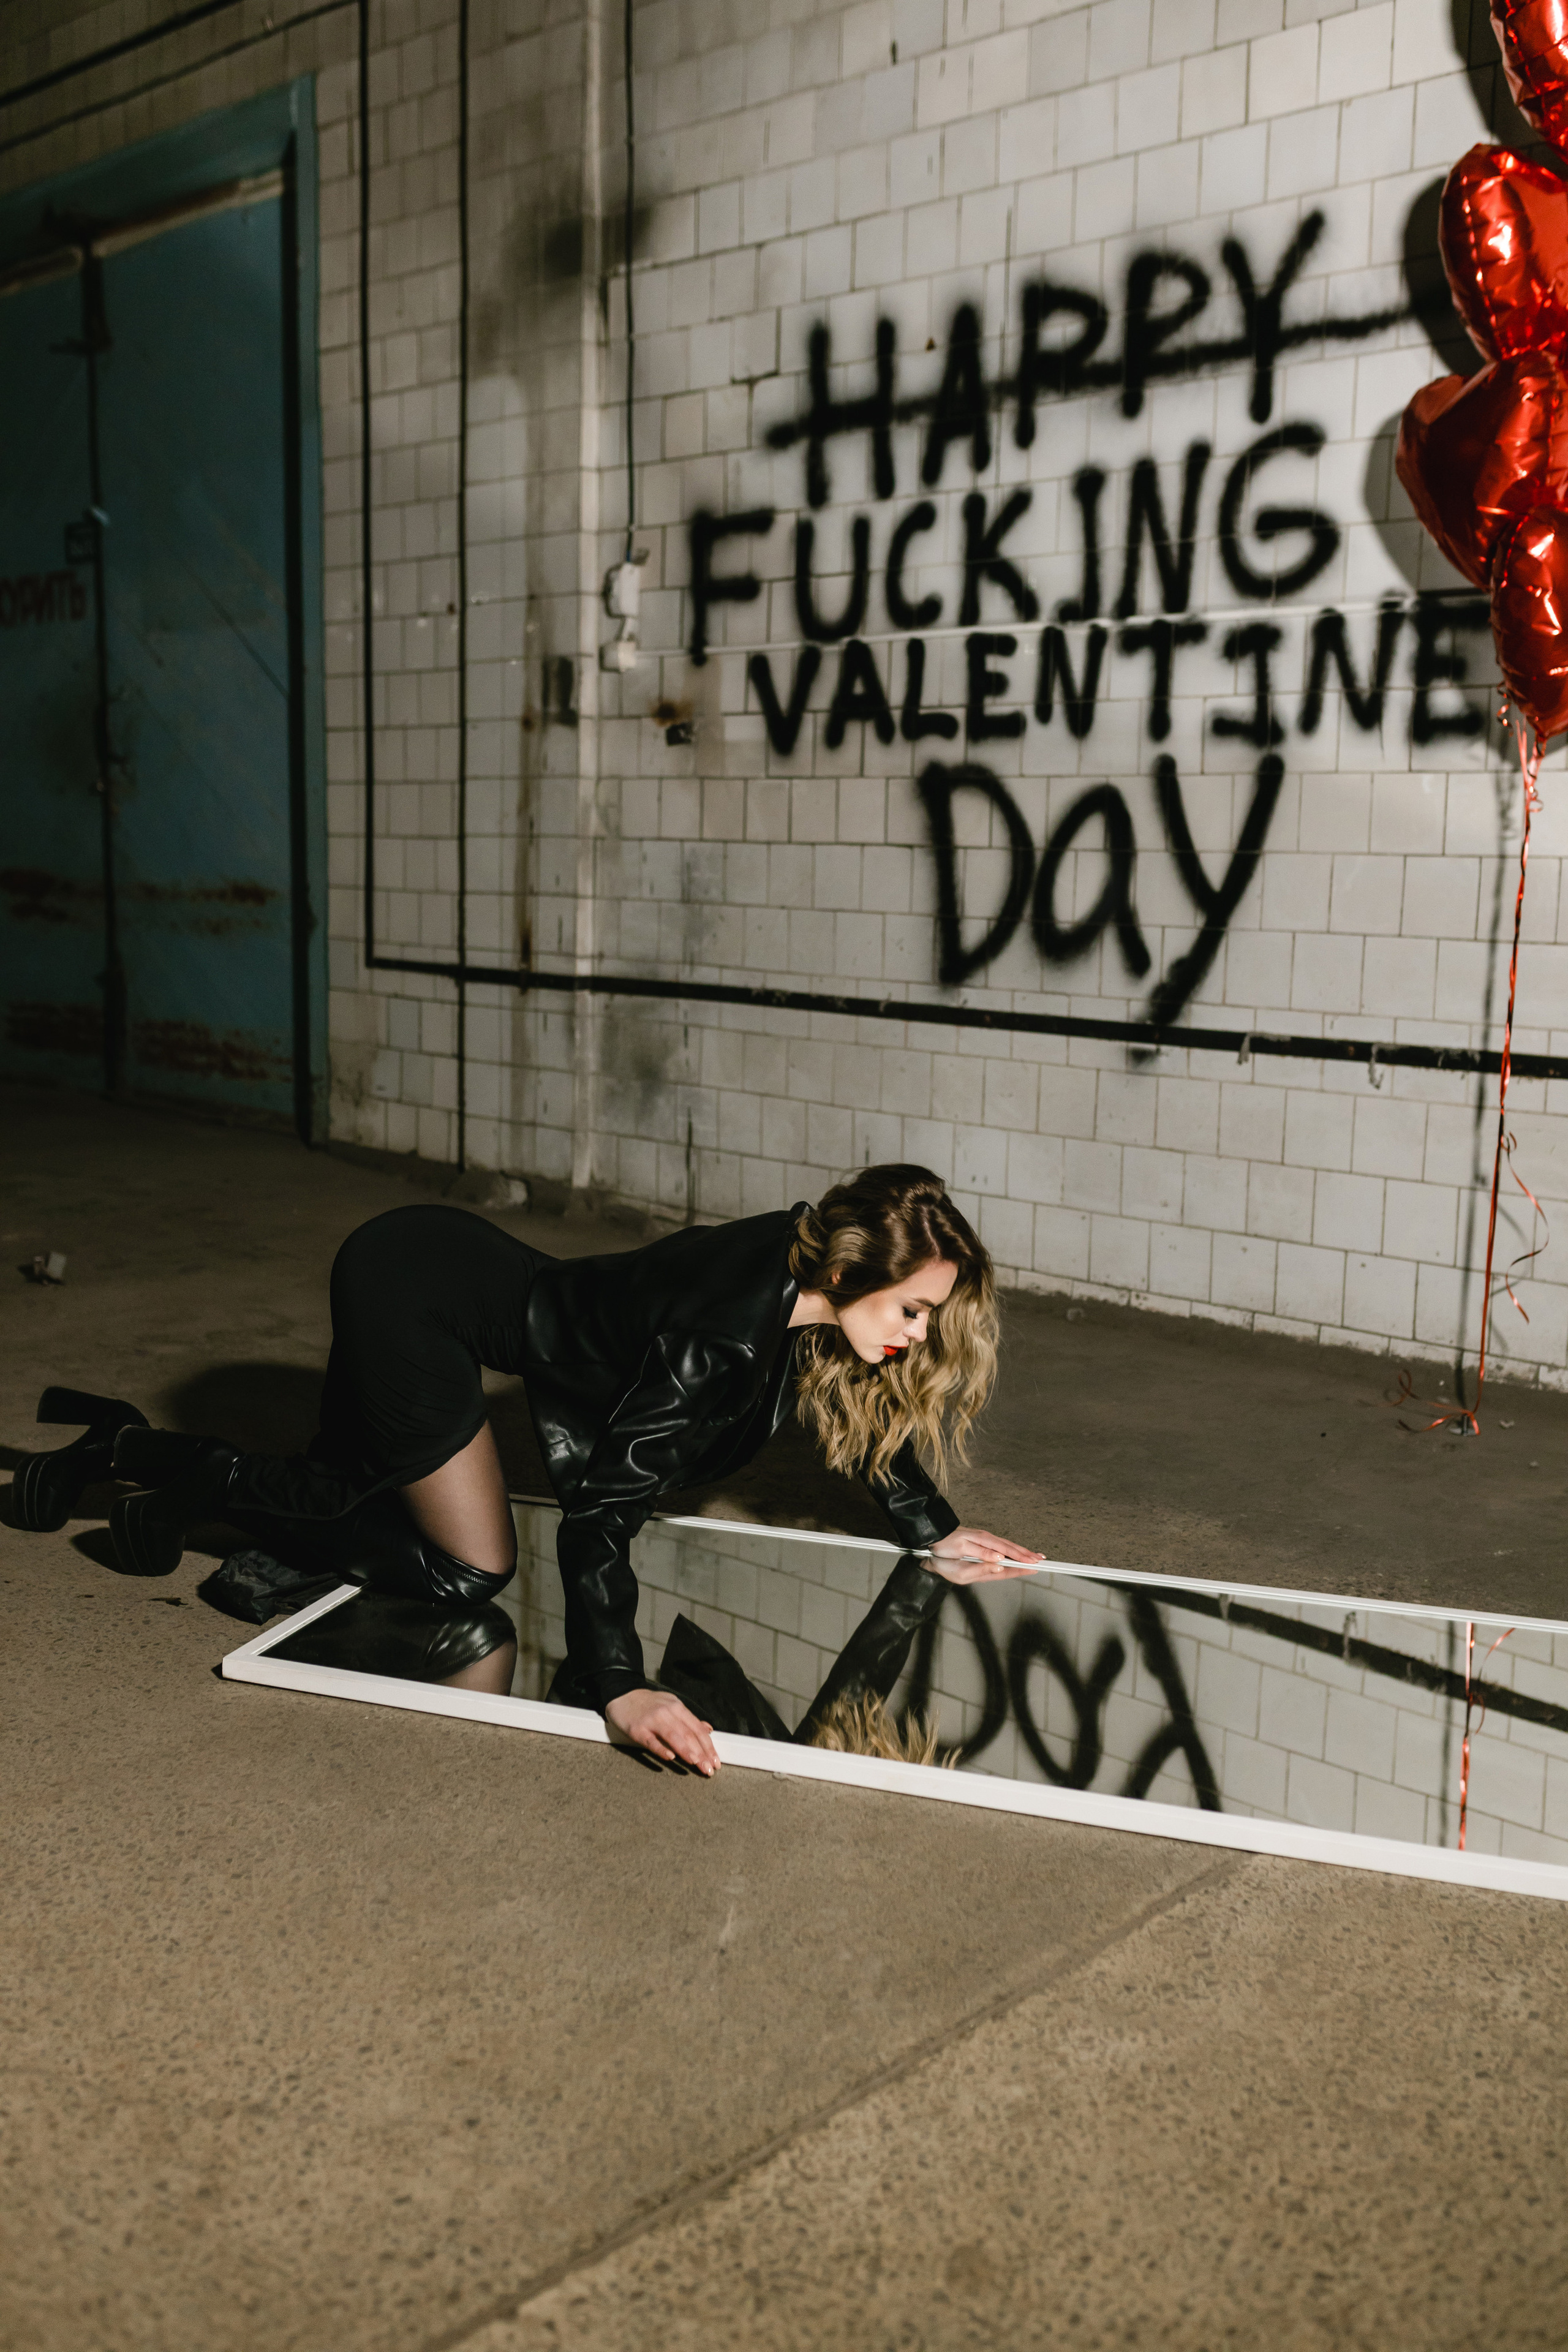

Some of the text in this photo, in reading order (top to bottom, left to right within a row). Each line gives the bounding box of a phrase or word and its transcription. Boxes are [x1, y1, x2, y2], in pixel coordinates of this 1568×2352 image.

[763, 207, 1330, 510] HAPPY
[687, 421, 1343, 666] FUCKING
[747, 599, 1493, 758] VALENTINE
